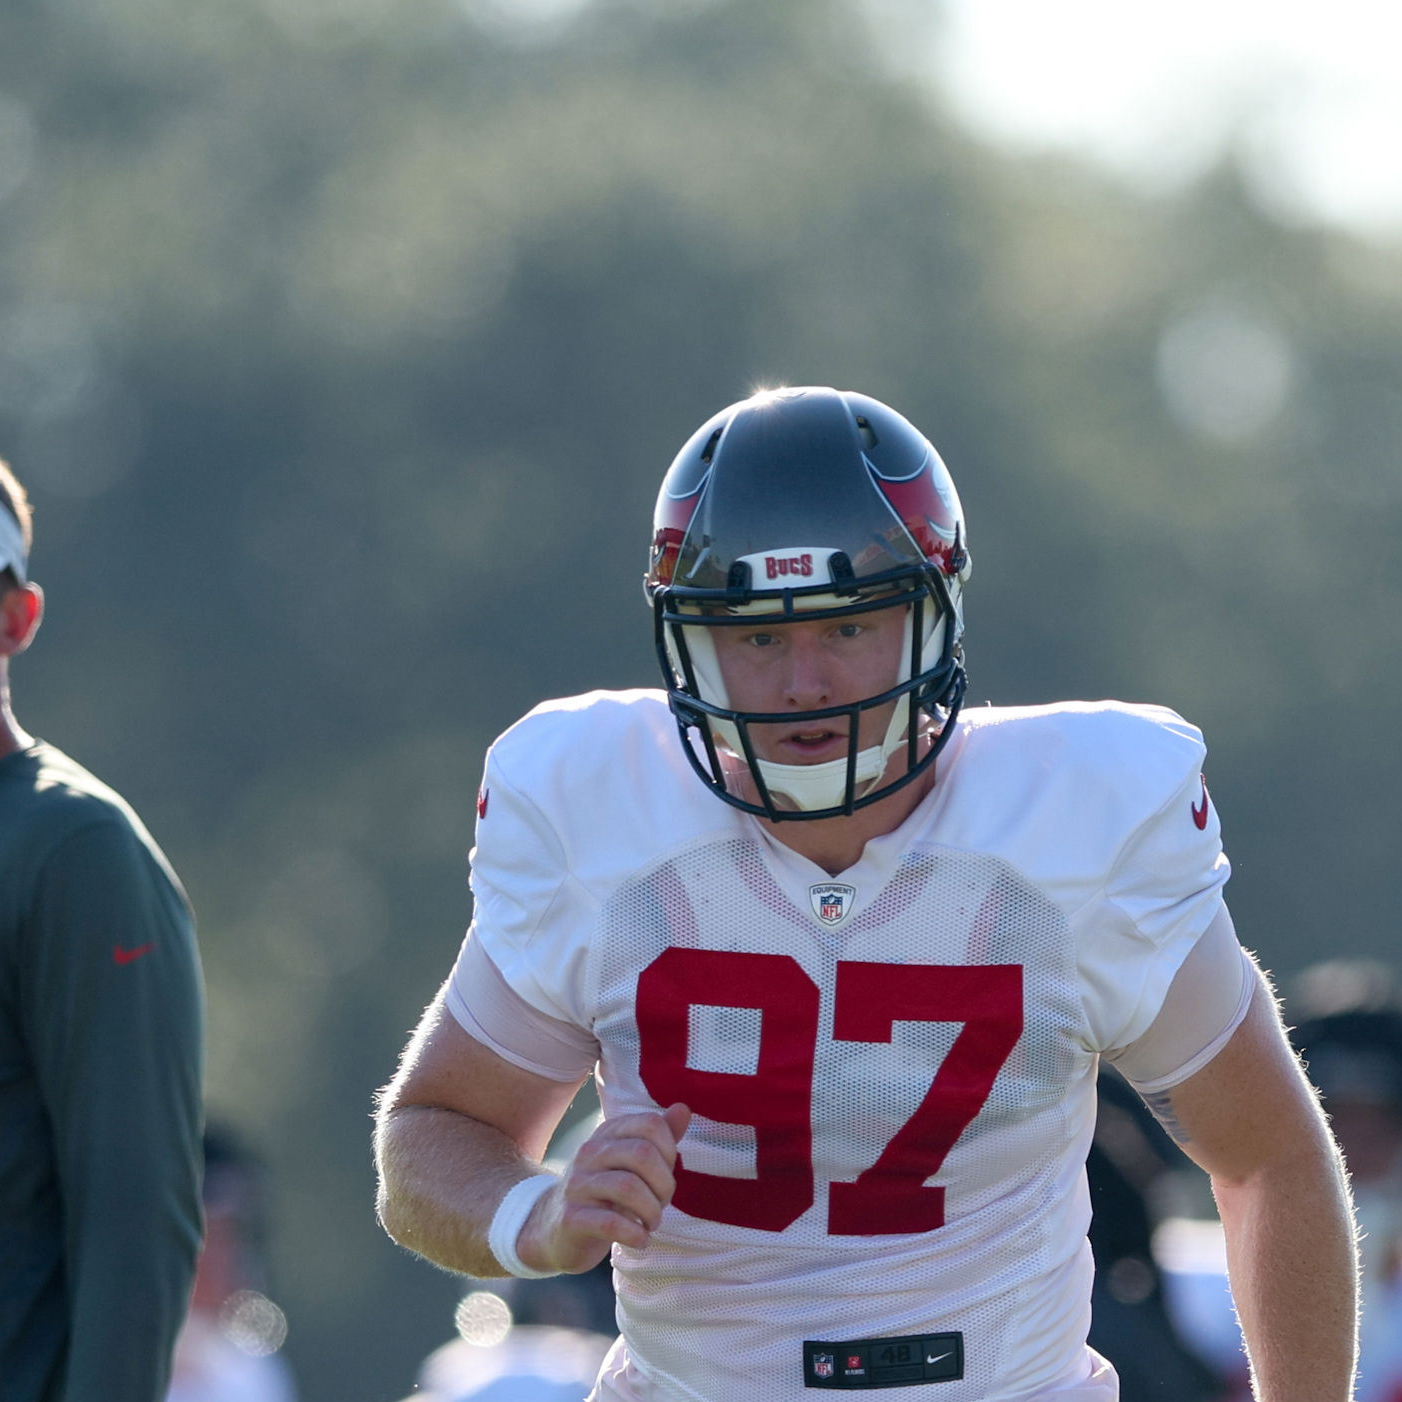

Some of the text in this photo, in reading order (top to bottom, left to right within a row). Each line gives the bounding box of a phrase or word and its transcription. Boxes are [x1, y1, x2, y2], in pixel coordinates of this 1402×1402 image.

[764, 553, 814, 580] BUCS
[822, 904, 843, 919] NFL
[636, 946, 1024, 1237] 97
